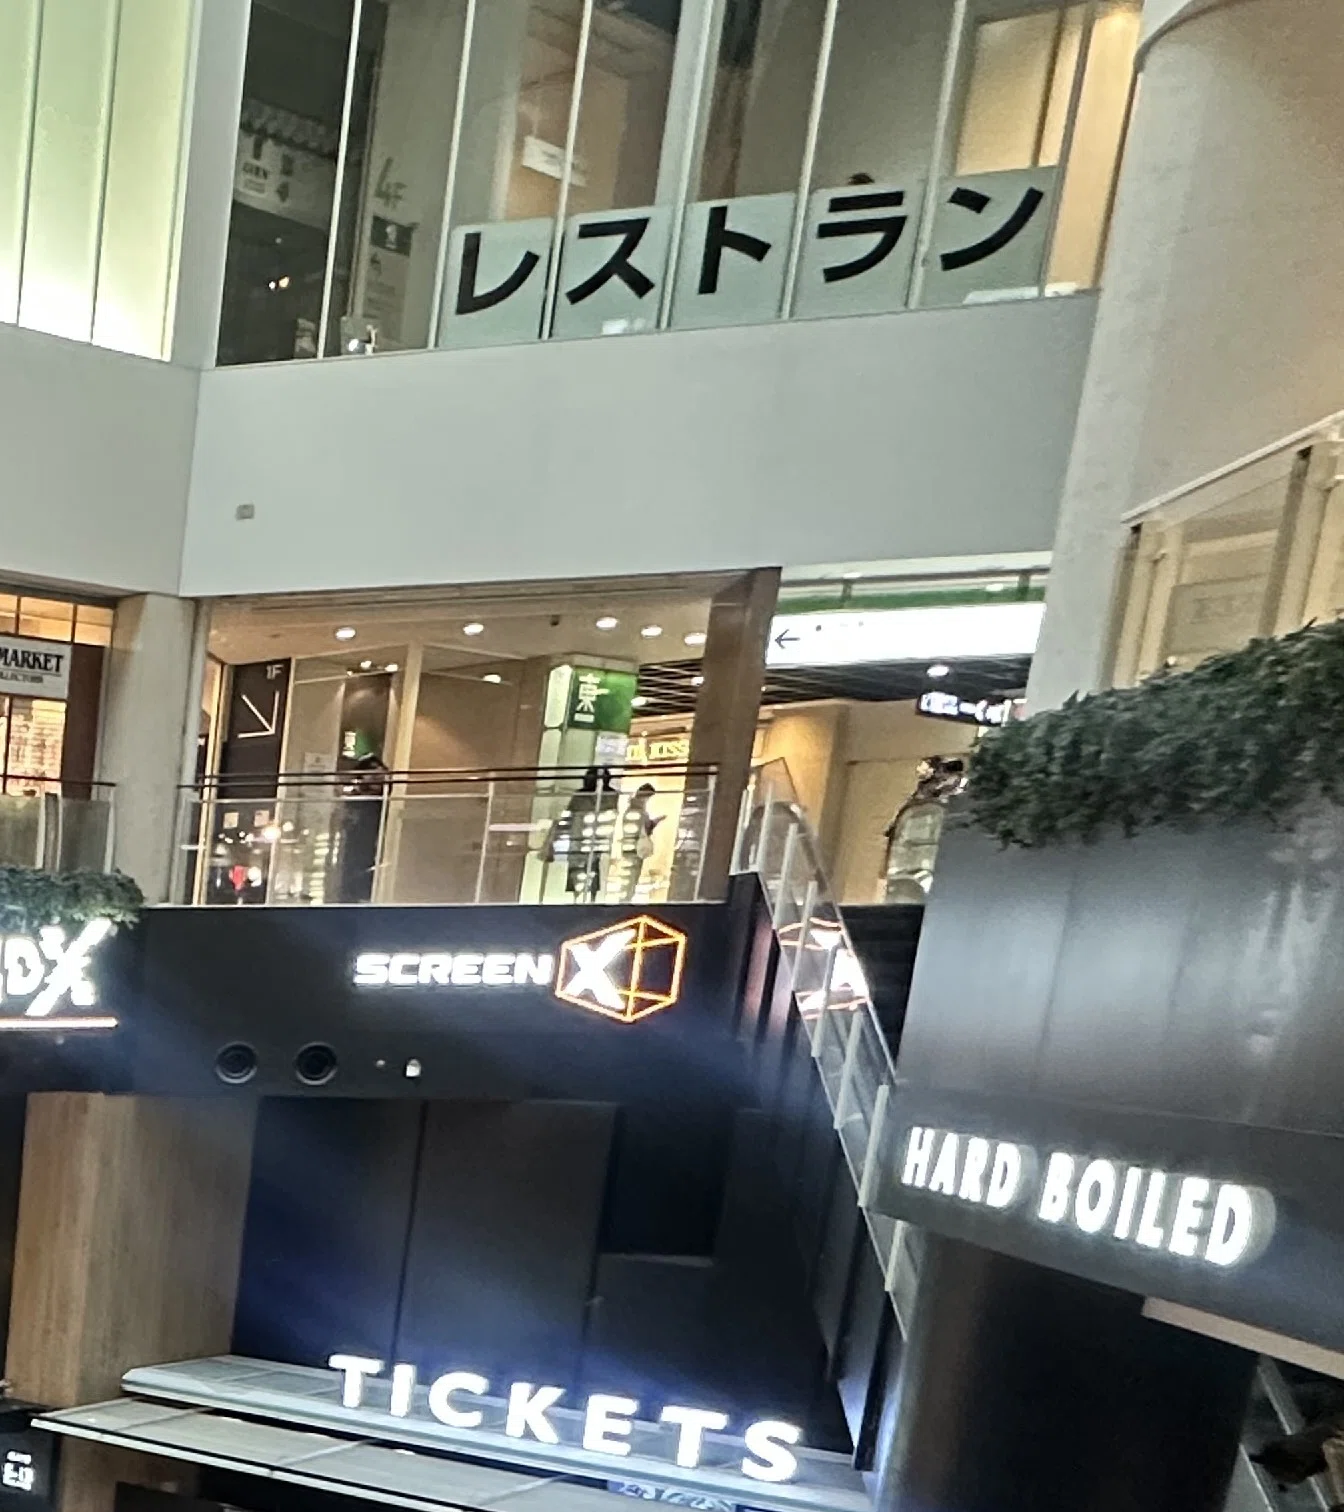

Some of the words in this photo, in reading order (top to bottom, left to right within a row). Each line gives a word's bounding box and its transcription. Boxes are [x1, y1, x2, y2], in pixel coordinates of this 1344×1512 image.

[455, 188, 1044, 316] レストラン
[901, 1124, 1024, 1208] HARD
[1037, 1151, 1256, 1267] BOILED
[327, 1353, 805, 1484] TICKETS
